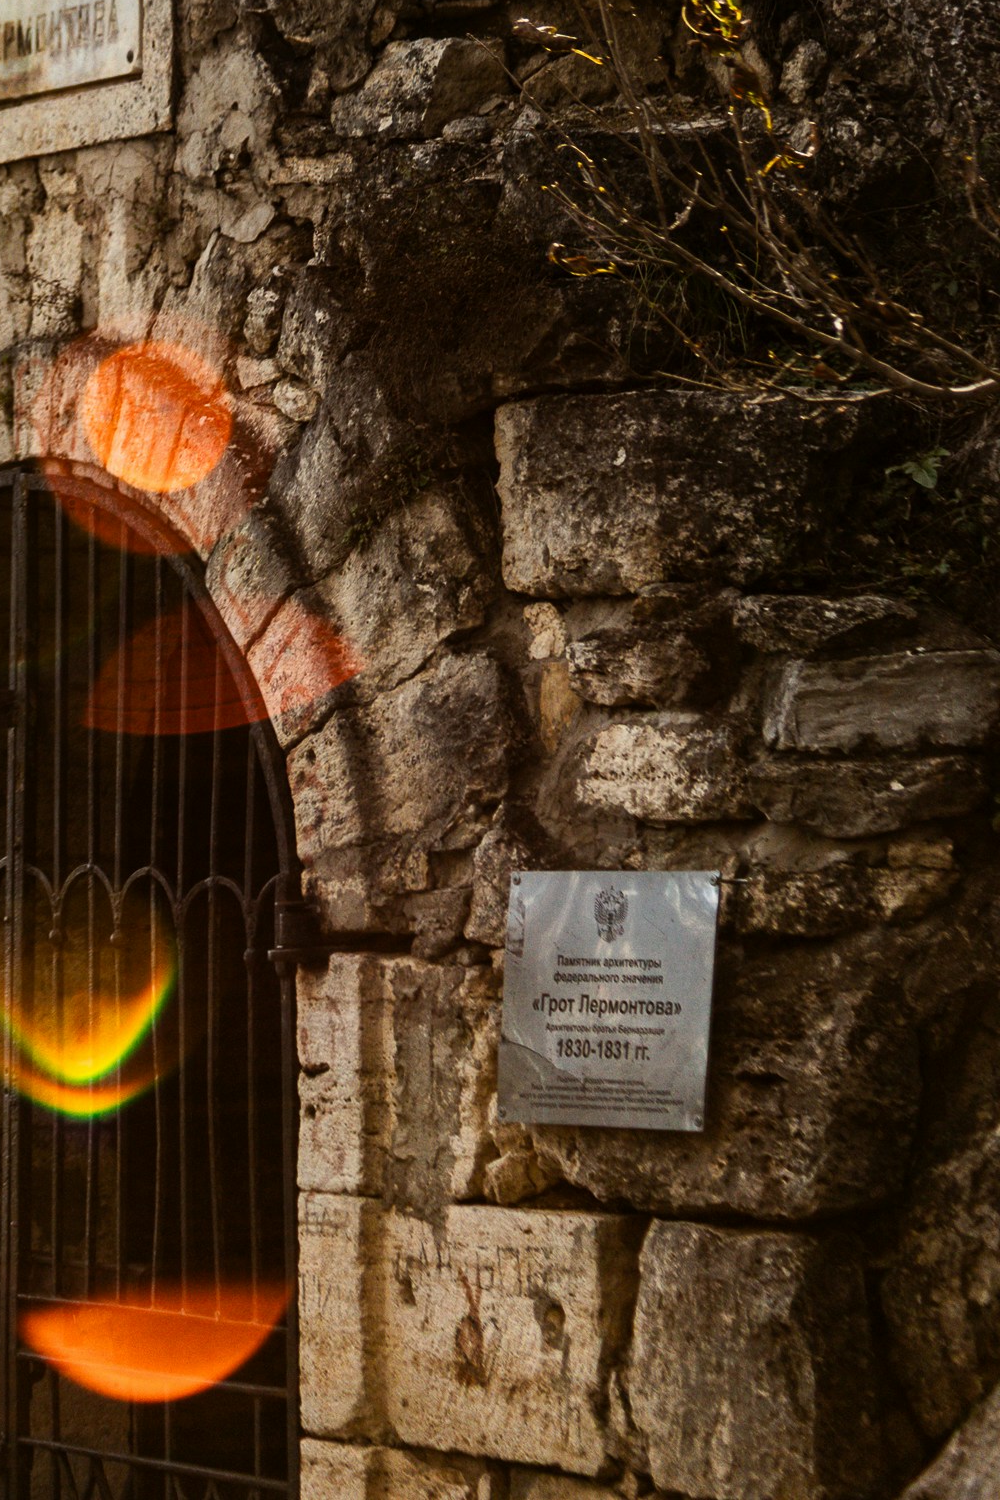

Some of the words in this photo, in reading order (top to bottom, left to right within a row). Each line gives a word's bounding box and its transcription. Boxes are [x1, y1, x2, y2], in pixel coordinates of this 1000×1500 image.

[557, 954, 601, 967] Памятник
[603, 957, 662, 970] архитектуры
[553, 971, 620, 985] федерального
[621, 974, 664, 985] значения
[532, 993, 575, 1016] «Грот
[578, 994, 683, 1018] Лермонтова»
[556, 1038, 630, 1060] 1830-1831
[635, 1045, 651, 1061] гг.
